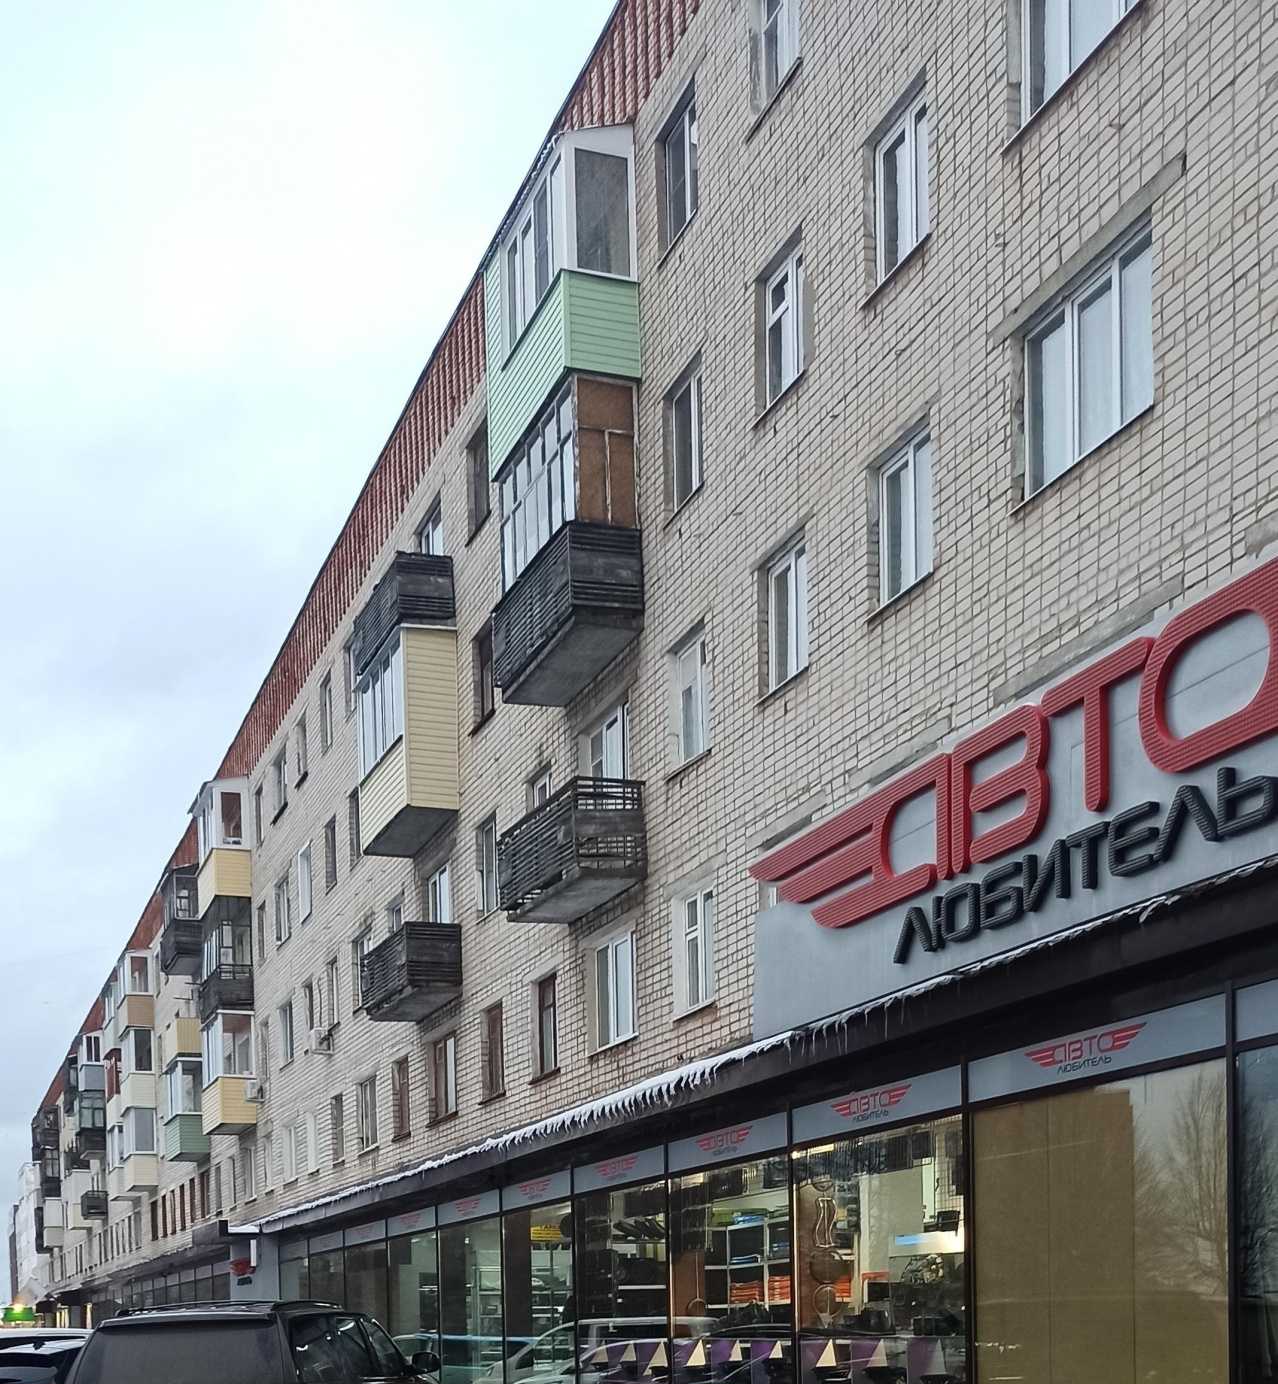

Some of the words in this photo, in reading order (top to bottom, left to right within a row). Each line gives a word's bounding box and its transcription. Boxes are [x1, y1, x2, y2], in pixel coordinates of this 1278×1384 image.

[866, 556, 1278, 892] АВТО
[893, 766, 1278, 964] ЛЮБИТЕЛЬ
[1057, 1056, 1112, 1074] ЛЮБИТЕЛЬ
